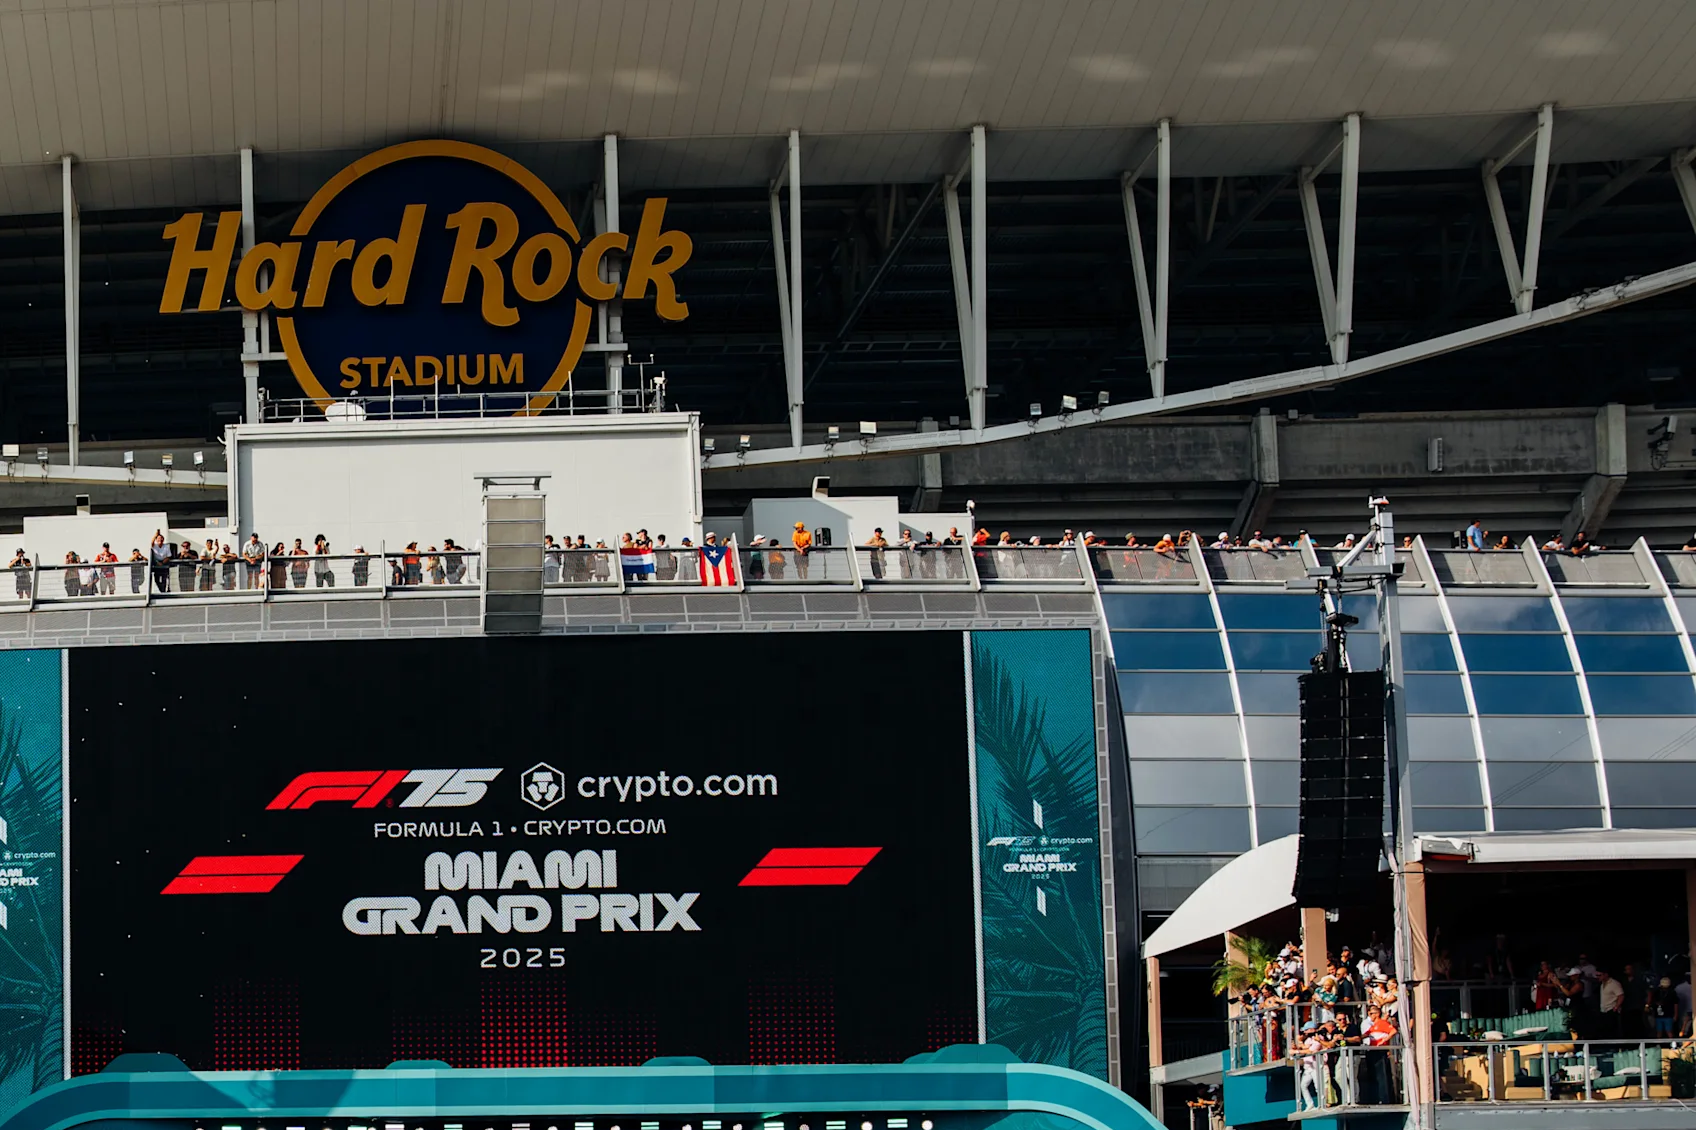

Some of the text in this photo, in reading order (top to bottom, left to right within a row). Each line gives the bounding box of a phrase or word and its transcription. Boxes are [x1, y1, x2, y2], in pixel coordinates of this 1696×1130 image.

[159, 198, 694, 326] Hard Rock
[339, 353, 525, 389] STADIUM
[399, 768, 503, 808] 75
[577, 770, 779, 802] crypto.com
[374, 818, 667, 838] FORMULA 1 CRYPTO.COM
[14, 851, 56, 859] crypto.com
[1020, 854, 1060, 863] MIAMI
[424, 849, 618, 890] MIAMI
[1003, 862, 1077, 872] GRAND PRIX
[10, 877, 39, 886] PRIX
[342, 893, 702, 935] GRAND PRIX
[480, 946, 567, 968] 2025
